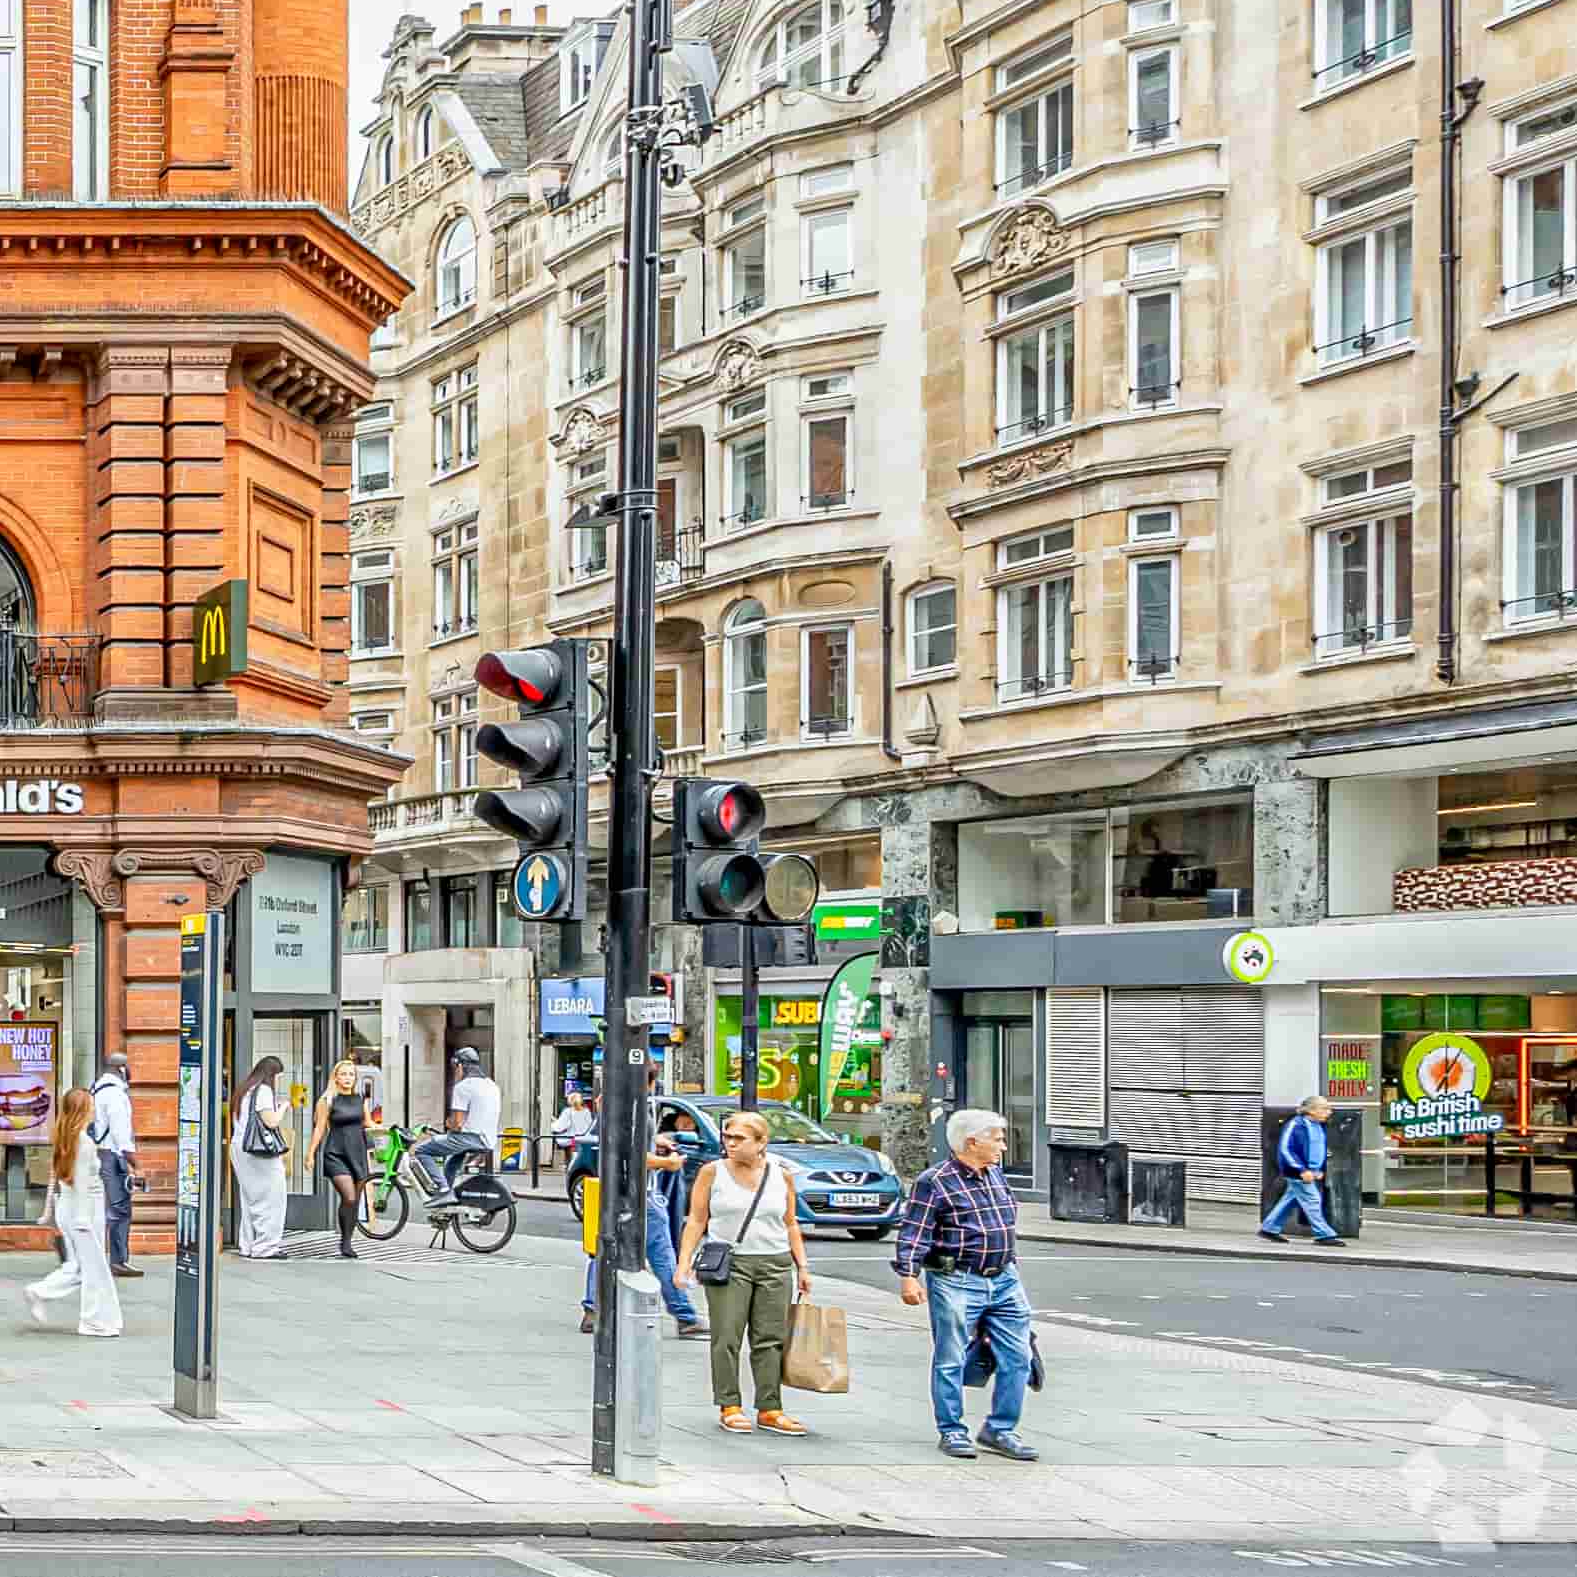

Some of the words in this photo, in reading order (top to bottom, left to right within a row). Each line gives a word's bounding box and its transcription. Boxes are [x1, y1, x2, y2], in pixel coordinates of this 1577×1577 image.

[547, 998, 594, 1014] LEBARA
[12, 1044, 53, 1060] HONEY
[1327, 1041, 1367, 1061] MADE
[1327, 1060, 1367, 1080] FRESH
[1390, 1099, 1416, 1121] It's
[1417, 1092, 1480, 1118] British
[1404, 1115, 1455, 1139] sushi
[1458, 1112, 1503, 1136] time
